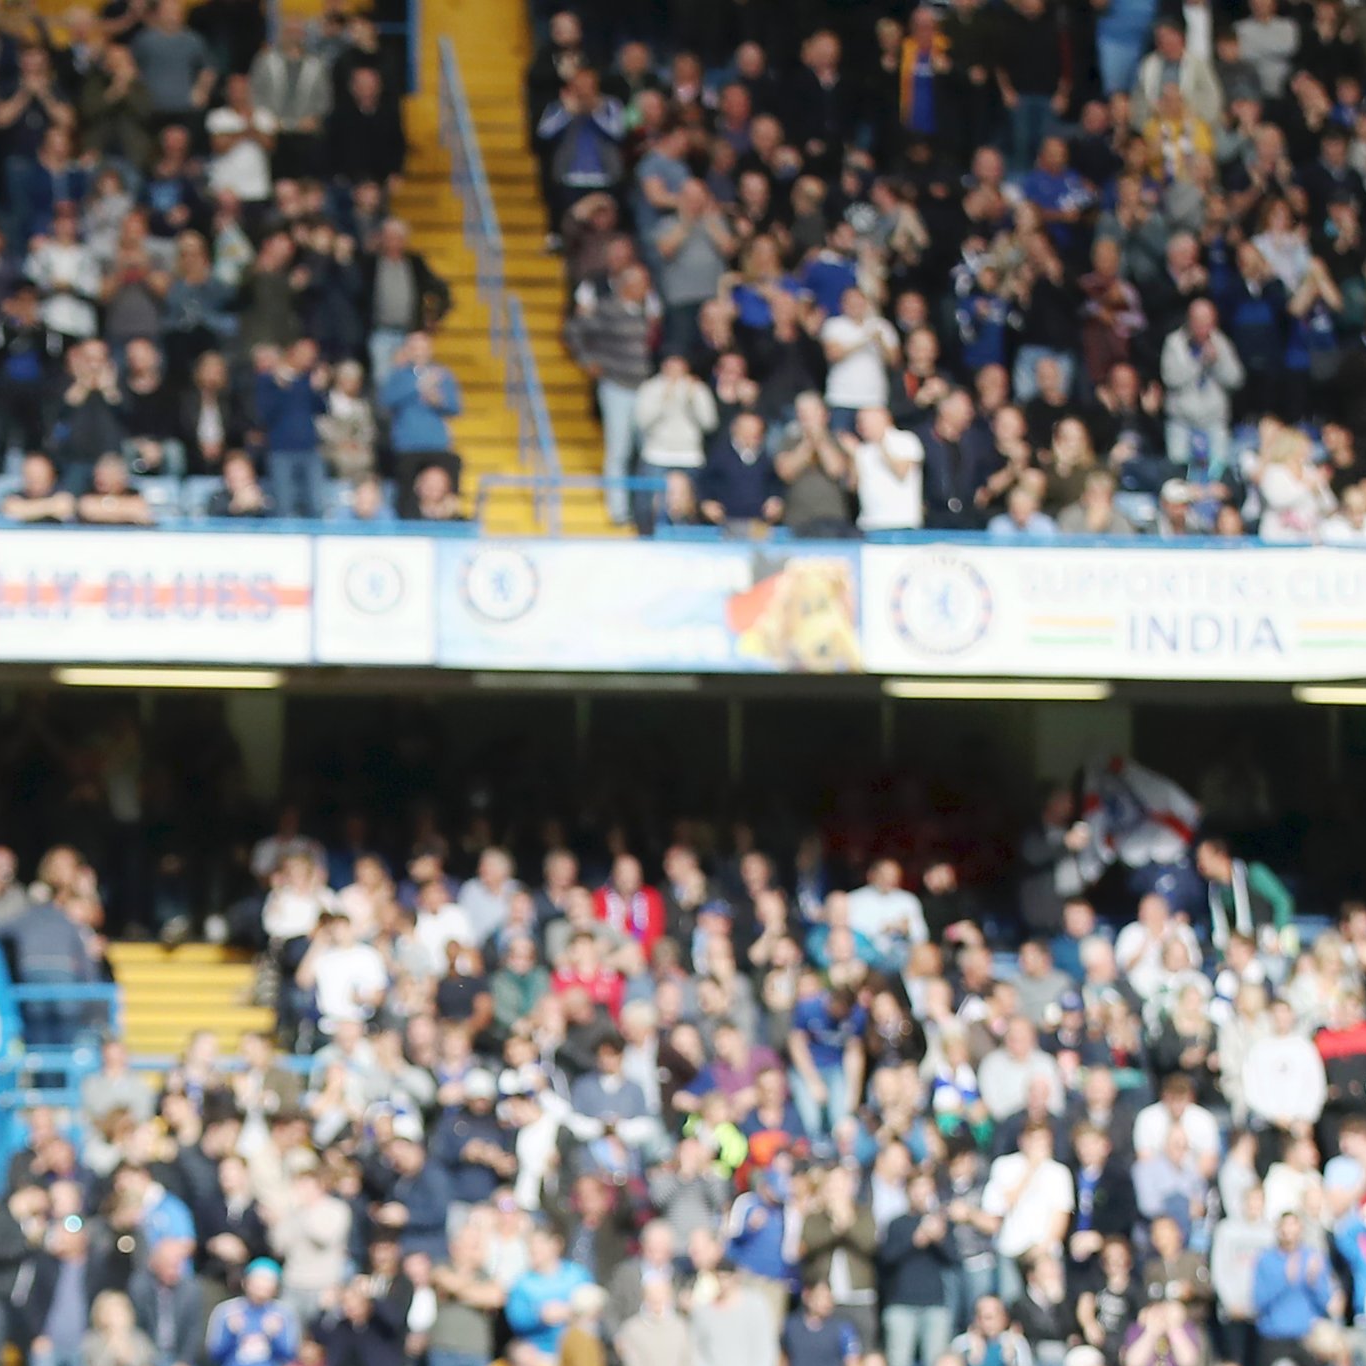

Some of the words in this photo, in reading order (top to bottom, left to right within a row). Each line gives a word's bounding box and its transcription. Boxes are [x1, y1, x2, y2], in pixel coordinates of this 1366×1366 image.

[107, 567, 279, 621] BLUES
[1017, 563, 1273, 602] SUPPORTERS
[1127, 612, 1285, 655] INDIA
